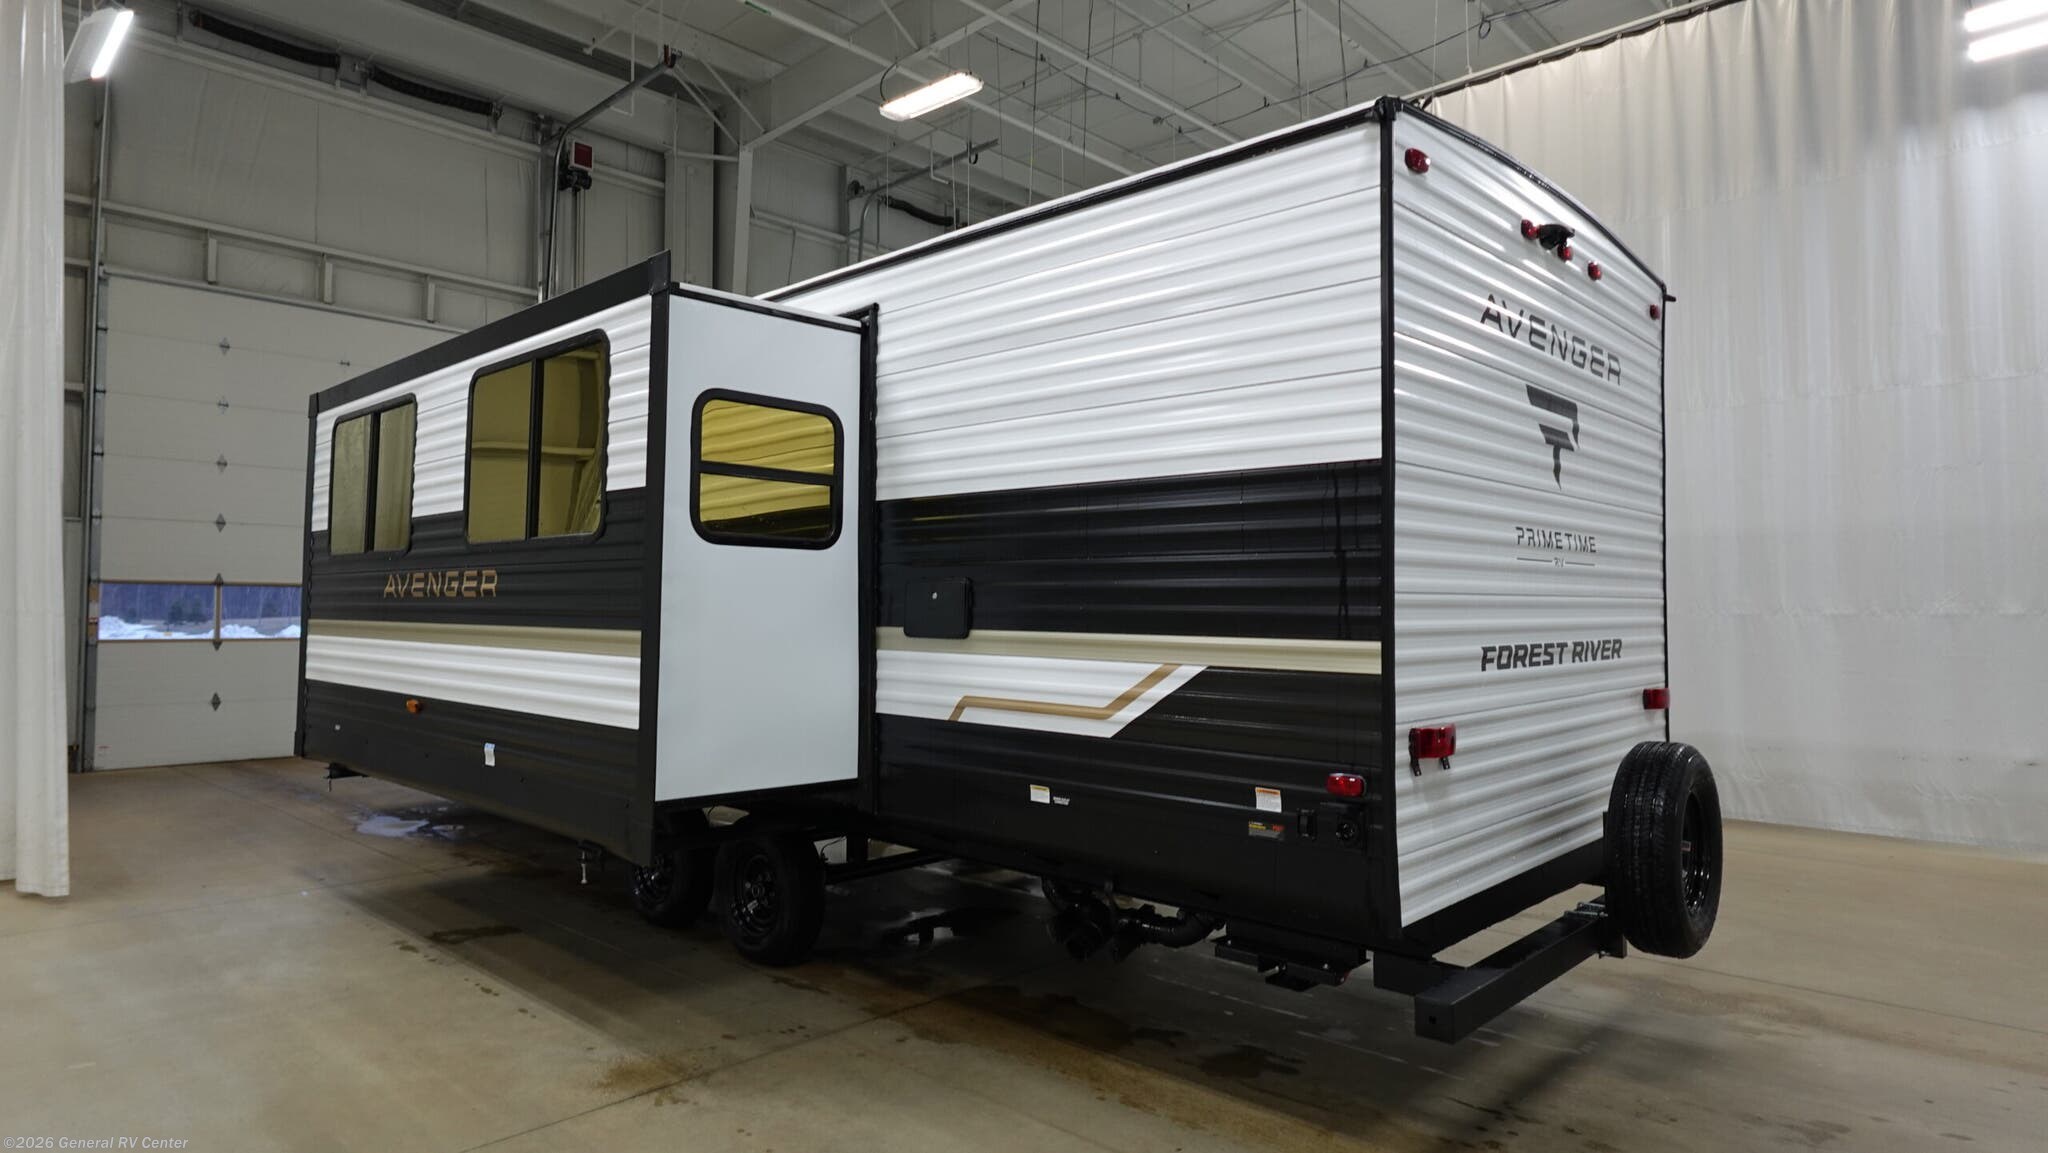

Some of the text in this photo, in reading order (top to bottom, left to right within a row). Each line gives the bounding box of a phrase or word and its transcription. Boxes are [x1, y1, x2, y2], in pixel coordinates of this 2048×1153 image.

[1480, 294, 1622, 385] AVENGER
[1553, 557, 1565, 568] RV
[383, 569, 498, 598] AVENGER
[1481, 639, 1623, 672] FOREST RIVER
